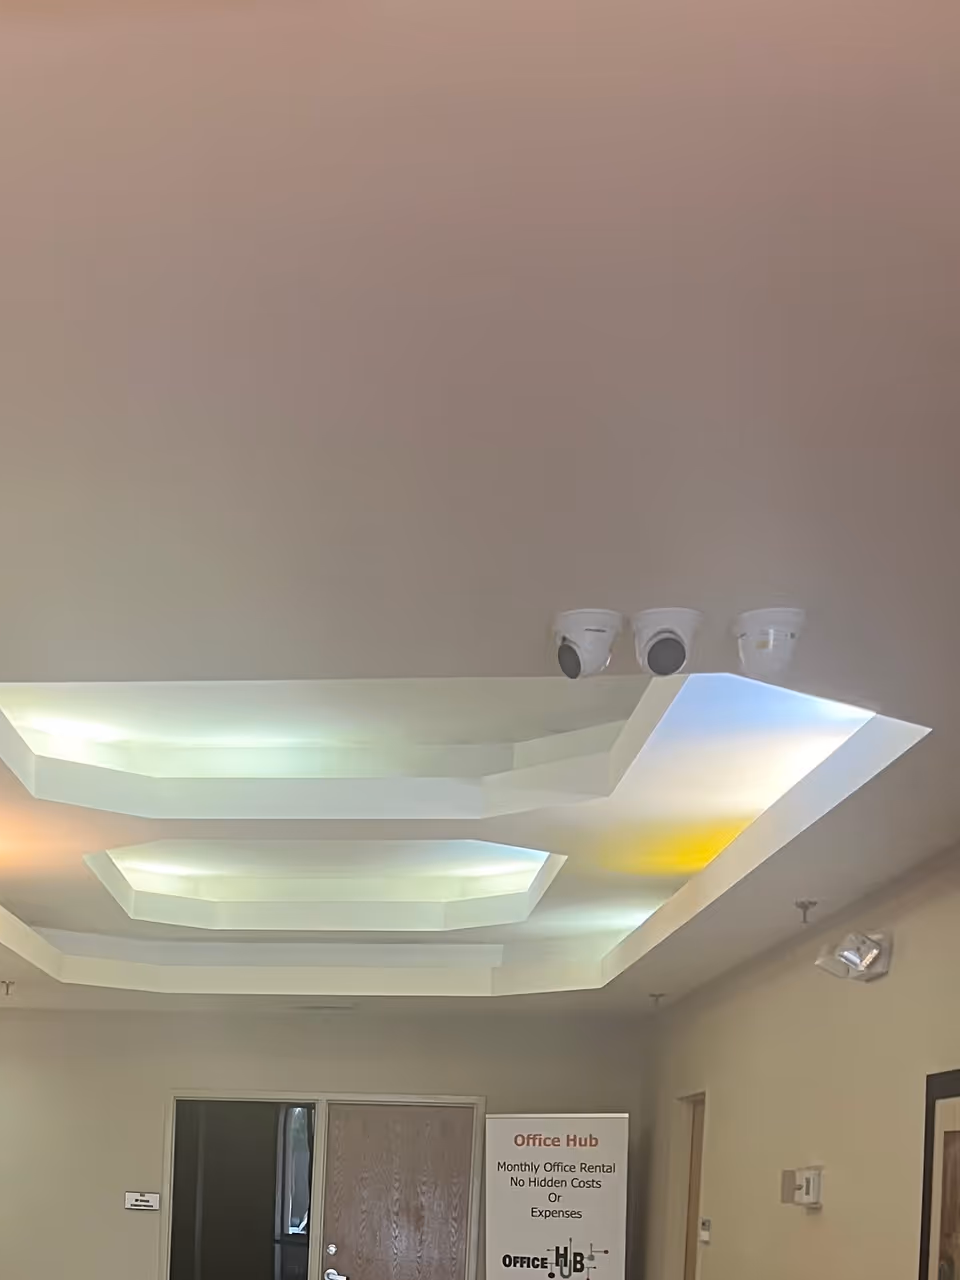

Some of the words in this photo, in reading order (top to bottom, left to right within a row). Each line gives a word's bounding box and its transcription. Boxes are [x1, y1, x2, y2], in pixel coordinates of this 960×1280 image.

[514, 1134, 561, 1147] Office
[566, 1134, 599, 1148] Hub
[497, 1161, 540, 1174] Monthly
[543, 1162, 576, 1173] Office
[579, 1162, 616, 1174] Rental
[510, 1177, 525, 1187] No
[528, 1177, 567, 1188] Hidden
[571, 1178, 602, 1189] Costs
[548, 1193, 563, 1203] Or
[531, 1207, 583, 1220] Expenses
[502, 1254, 548, 1269] OFFICE
